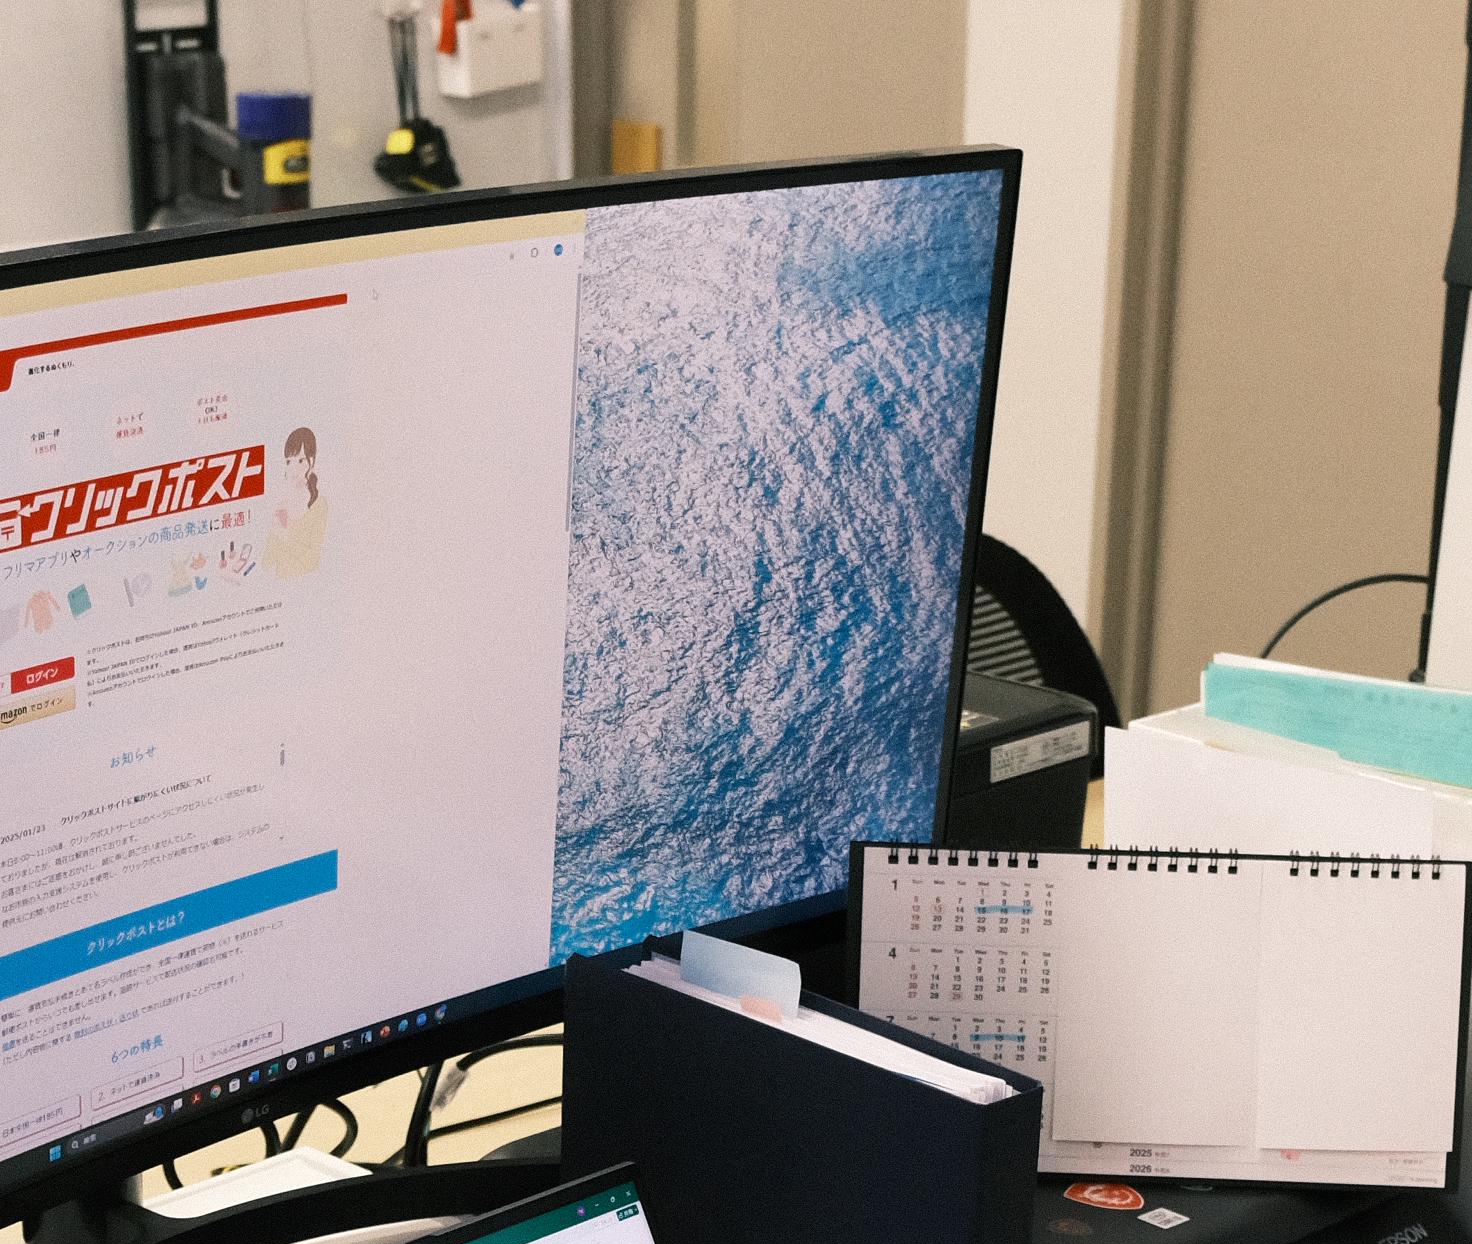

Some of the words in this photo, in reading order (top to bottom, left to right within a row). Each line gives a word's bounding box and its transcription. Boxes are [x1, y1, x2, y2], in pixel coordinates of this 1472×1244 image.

[30, 428, 60, 442] 全国一律
[29, 451, 263, 543] クリックポスト
[26, 667, 59, 684] ログイン
[30, 697, 63, 712] でログイン
[111, 745, 156, 769] お知らせ
[891, 879, 898, 890] 1
[87, 911, 185, 956] クリックポストとは？
[888, 948, 896, 959] 4
[111, 1034, 164, 1064] 6つの特長
[255, 1104, 270, 1117] LG
[1130, 1148, 1152, 1158] 2025
[1130, 1164, 1152, 1174] 2026
